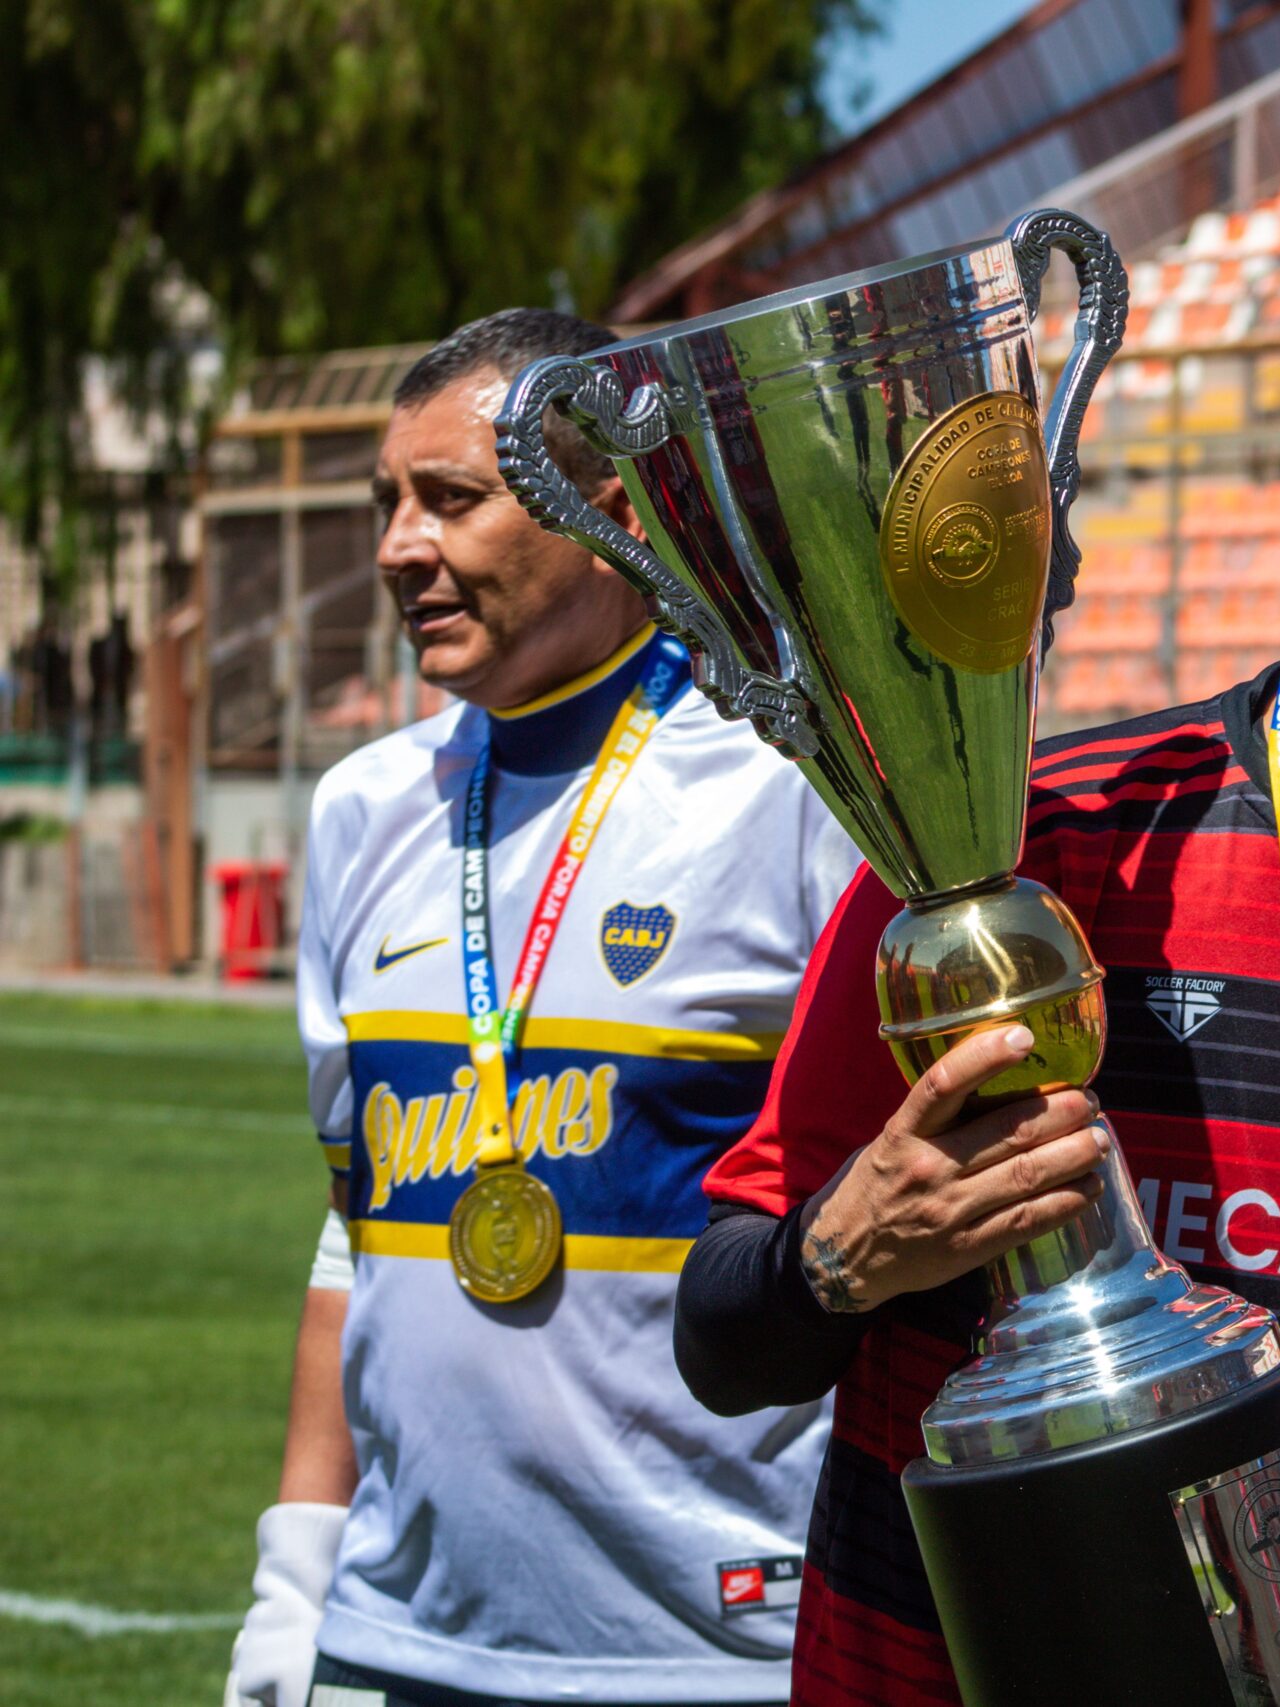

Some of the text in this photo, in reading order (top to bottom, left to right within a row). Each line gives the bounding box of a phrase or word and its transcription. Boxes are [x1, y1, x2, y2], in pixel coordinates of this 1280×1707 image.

[1009, 437, 1022, 450] DE
[893, 421, 970, 553] MUNICIPALIDAD
[974, 406, 995, 426] DE
[539, 854, 580, 920] FORJA
[465, 915, 487, 953] DE
[468, 956, 493, 1035] COPA
[1144, 976, 1226, 993] SOCCER FACTORY
